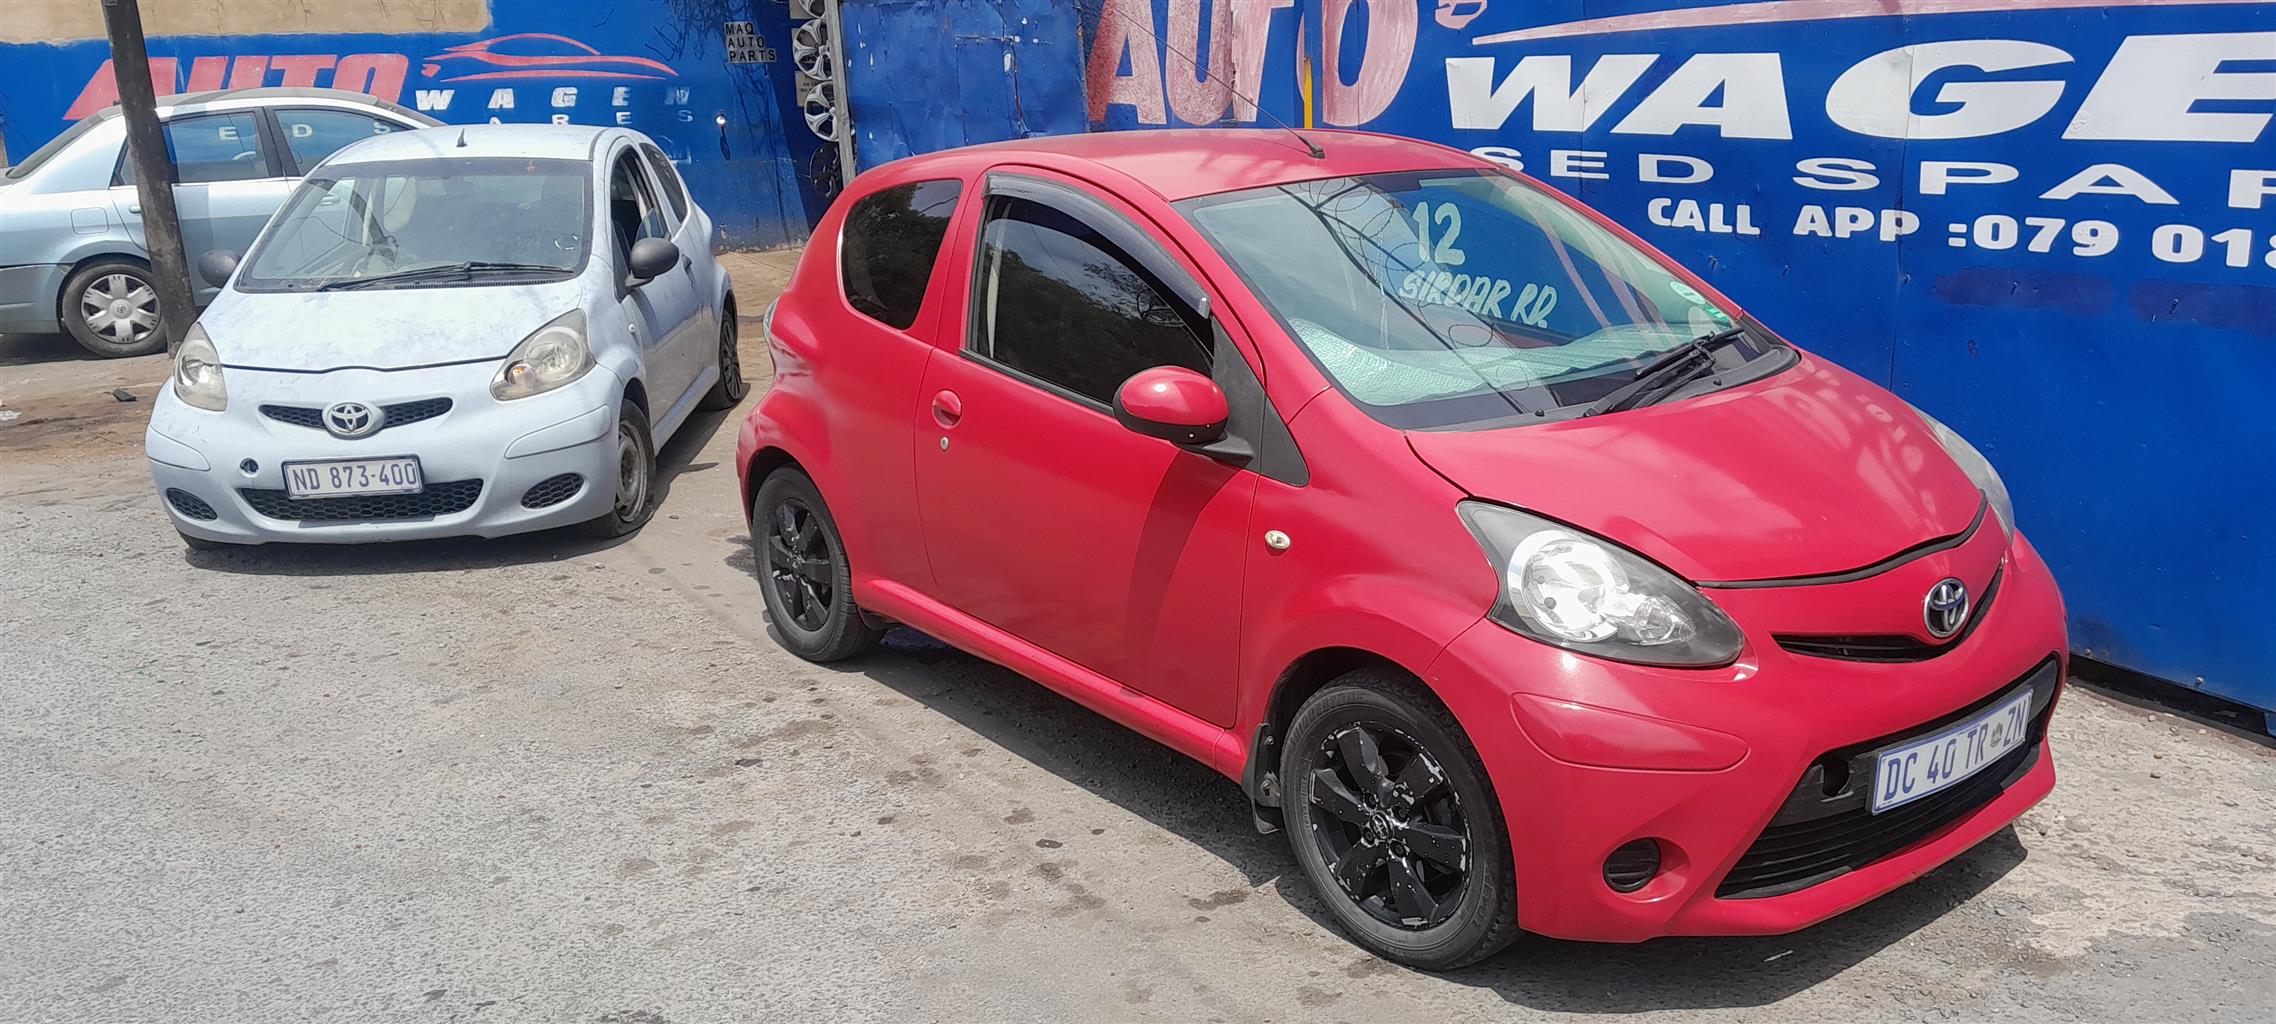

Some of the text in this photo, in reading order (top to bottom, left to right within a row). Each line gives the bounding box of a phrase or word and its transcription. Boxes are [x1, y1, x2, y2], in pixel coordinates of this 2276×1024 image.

[725, 22, 754, 35] MAQ
[728, 36, 765, 48] AUTO
[730, 49, 776, 62] PARTS
[63, 54, 409, 120] AUTO
[1086, 0, 1418, 126] AUTO
[1445, 31, 2276, 142] WAGE
[415, 86, 691, 111] WAGEN
[1470, 147, 1714, 184] SED
[1412, 201, 1465, 265] 12
[1648, 198, 2276, 270] CALL APP :079 01
[1399, 270, 1558, 328] SIRDAR RD.
[292, 463, 417, 491] ND 873-400
[1884, 699, 2029, 801] DC 40 TR ZN
